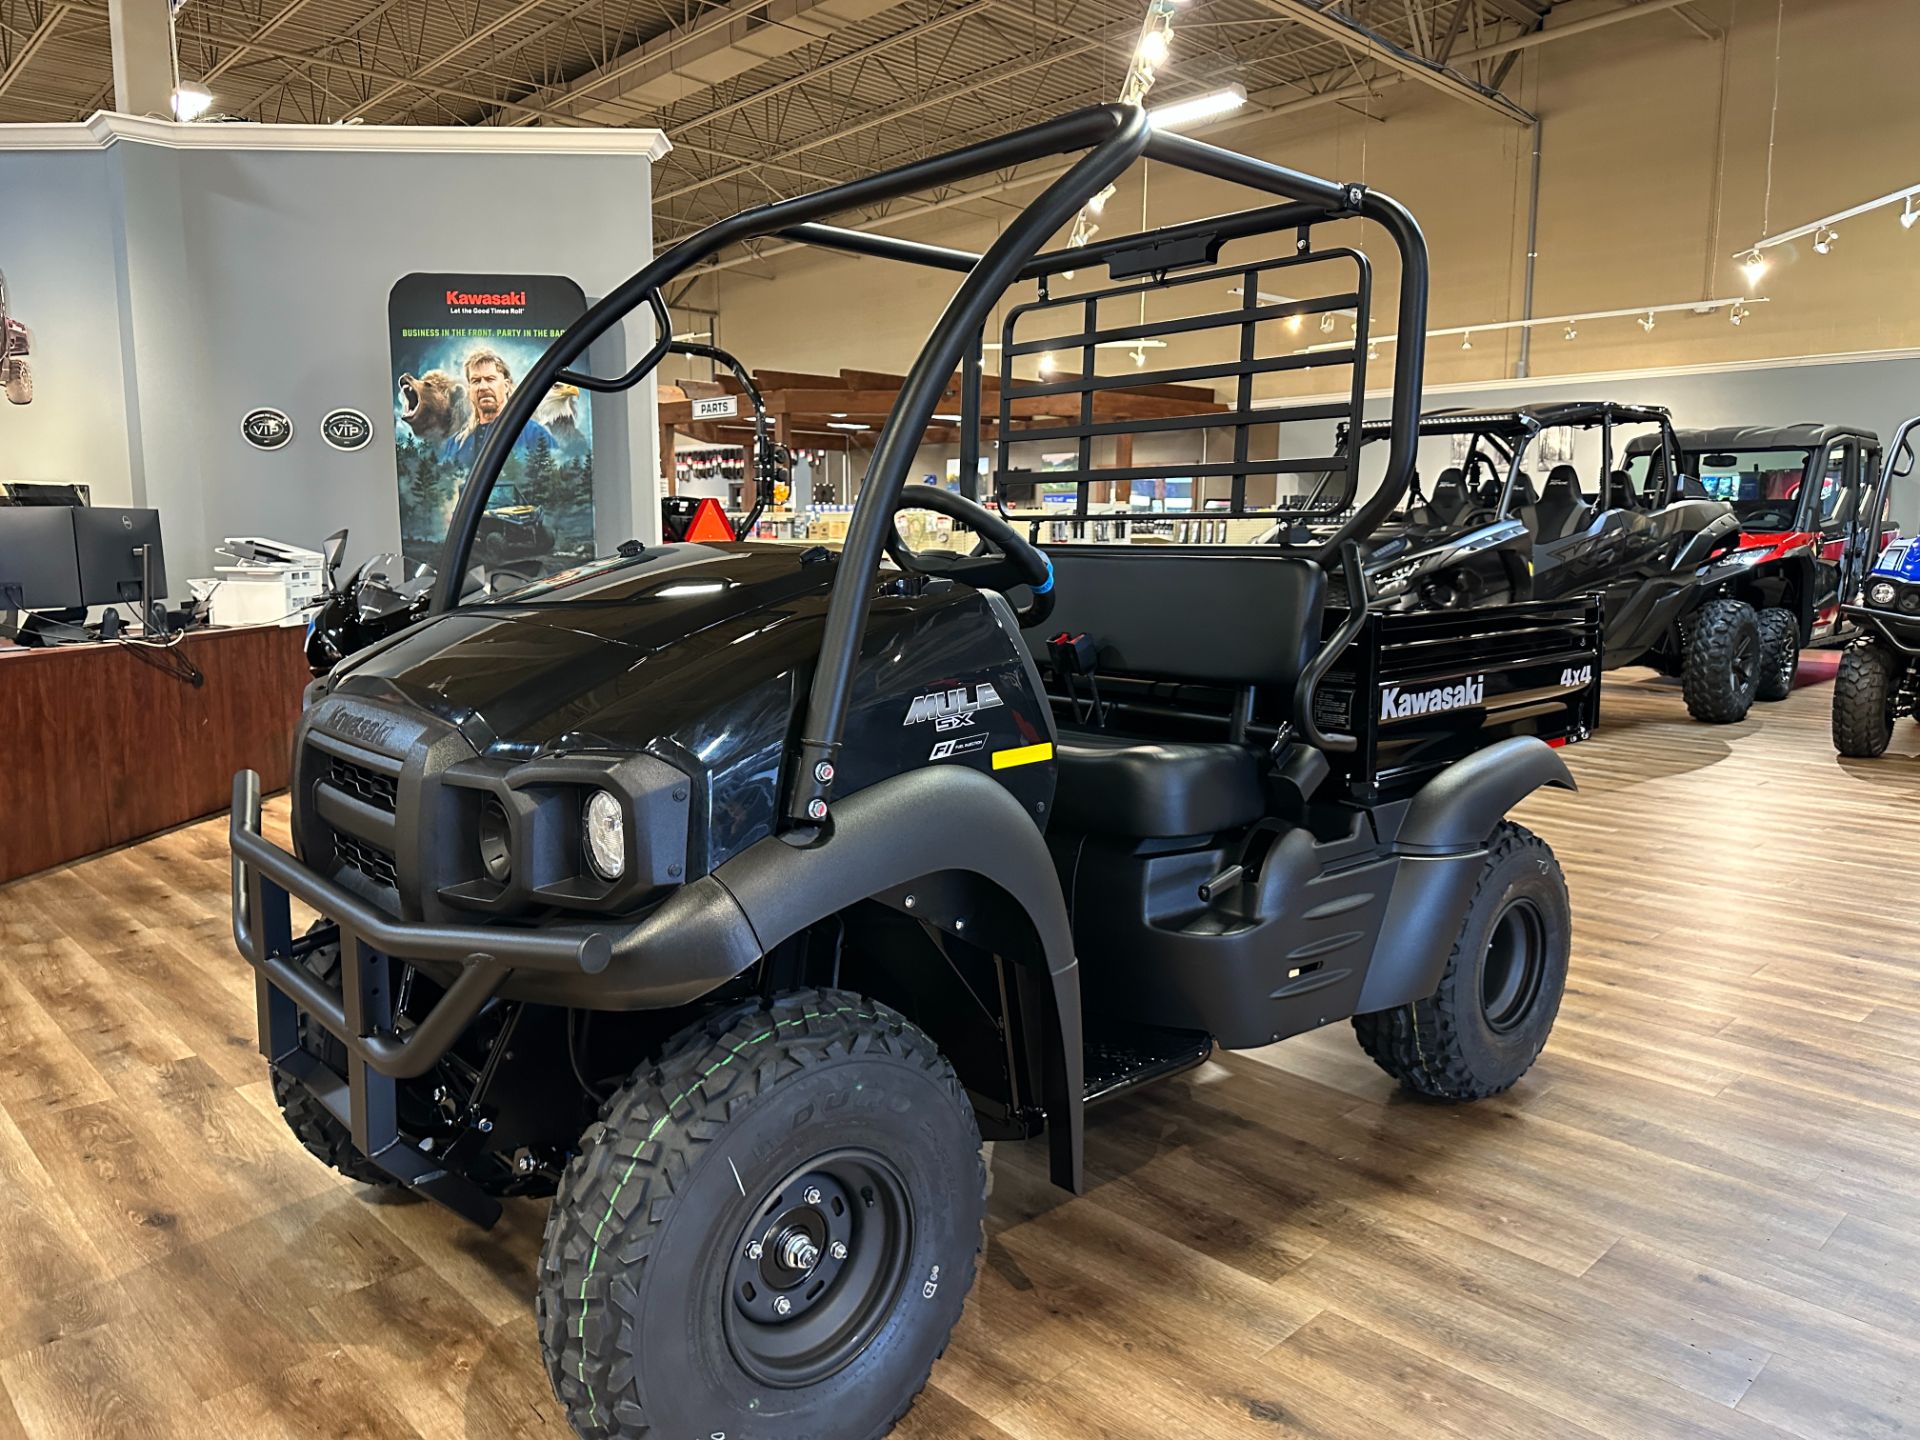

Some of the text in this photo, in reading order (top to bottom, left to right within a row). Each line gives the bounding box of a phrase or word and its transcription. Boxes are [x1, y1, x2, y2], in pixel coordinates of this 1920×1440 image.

[446, 291, 526, 305] Kawasaki
[402, 328, 567, 338] BUSINESS IN THE FRONT. PARTY IN THE BAC
[701, 402, 728, 414] PARTS
[253, 425, 280, 435] VIP
[332, 426, 359, 436] VIP
[1560, 665, 1592, 687] 4x4
[903, 683, 1004, 726] MULE
[1381, 675, 1484, 720] Kawasaki
[936, 711, 976, 732] SX
